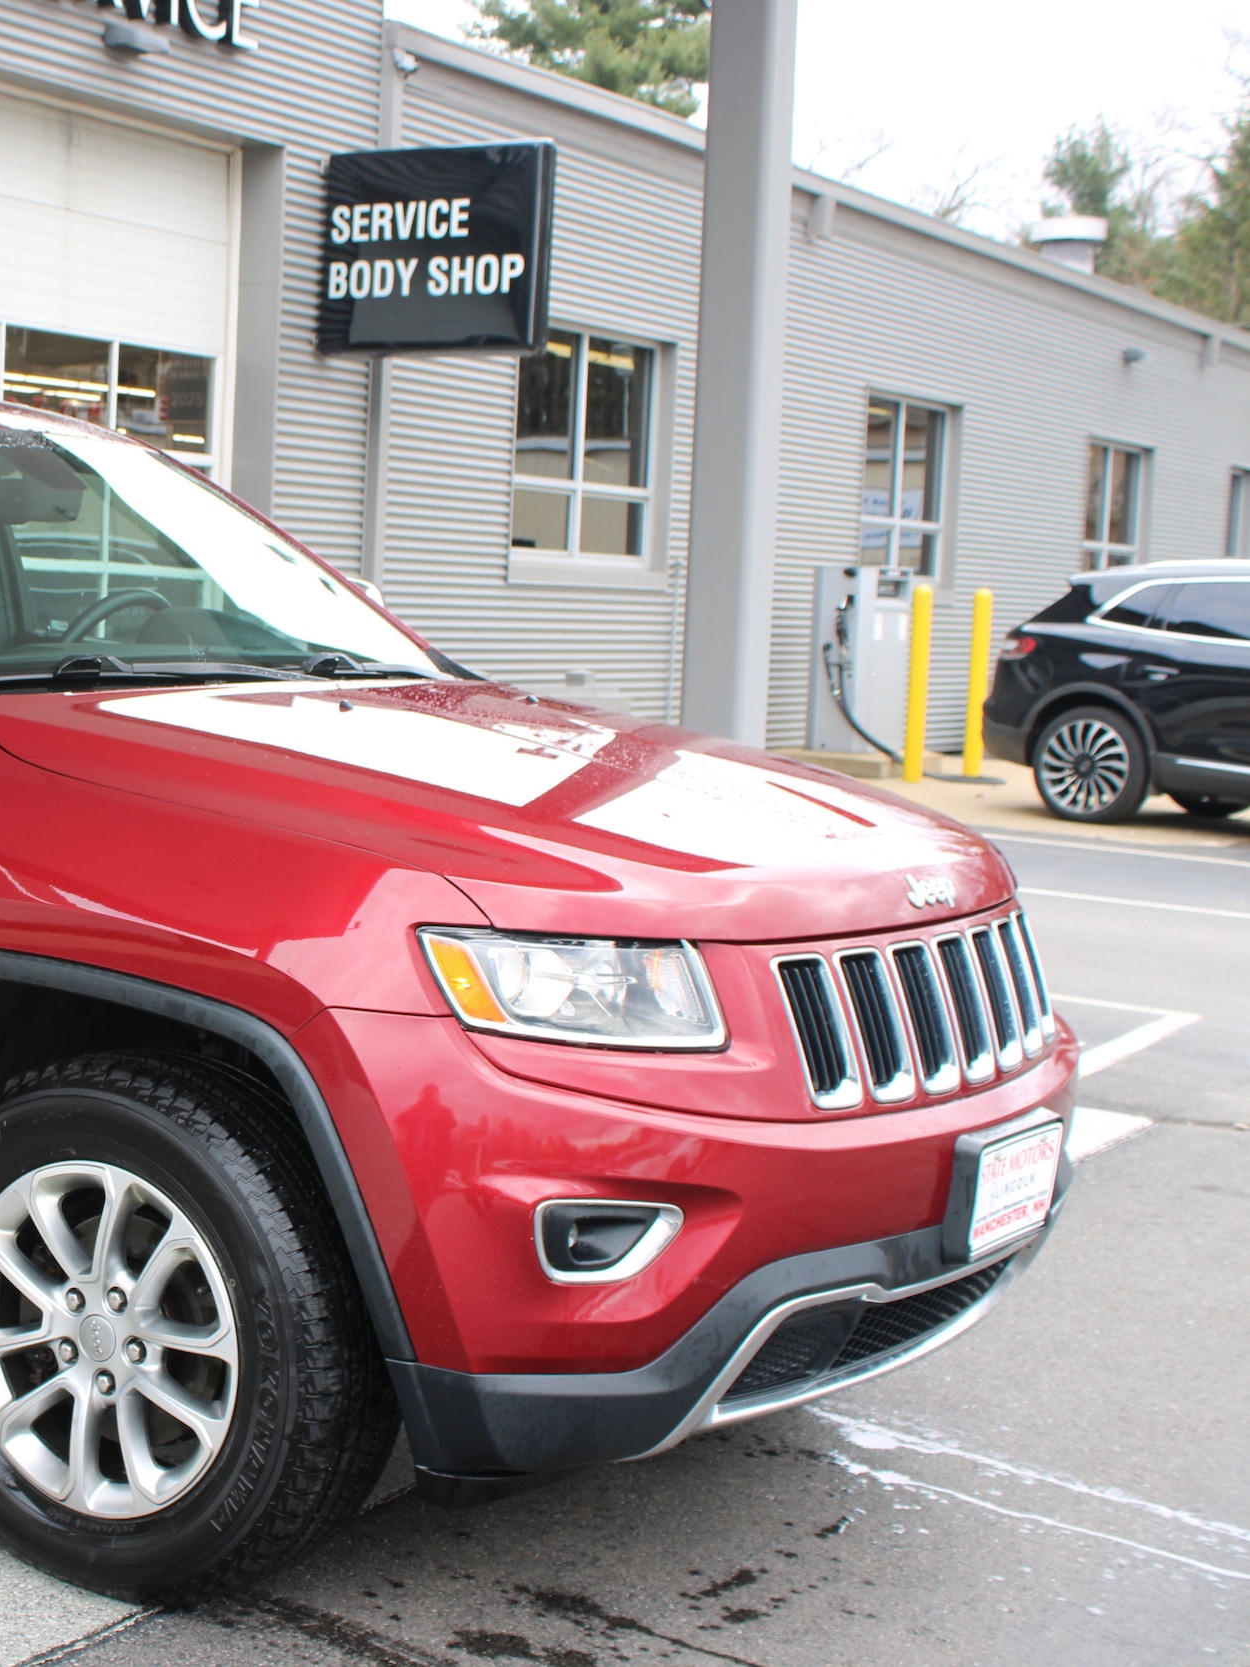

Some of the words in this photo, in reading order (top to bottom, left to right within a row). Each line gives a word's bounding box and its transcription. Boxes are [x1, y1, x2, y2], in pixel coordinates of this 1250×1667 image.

[330, 197, 471, 245] SERVICE
[327, 257, 419, 300] BODY
[426, 253, 525, 297] SHOP
[905, 873, 956, 910] Jeep
[980, 1155, 1008, 1187] STATE
[1009, 1139, 1055, 1171] MOTORS
[209, 1290, 280, 1533] YOKOHAMA
